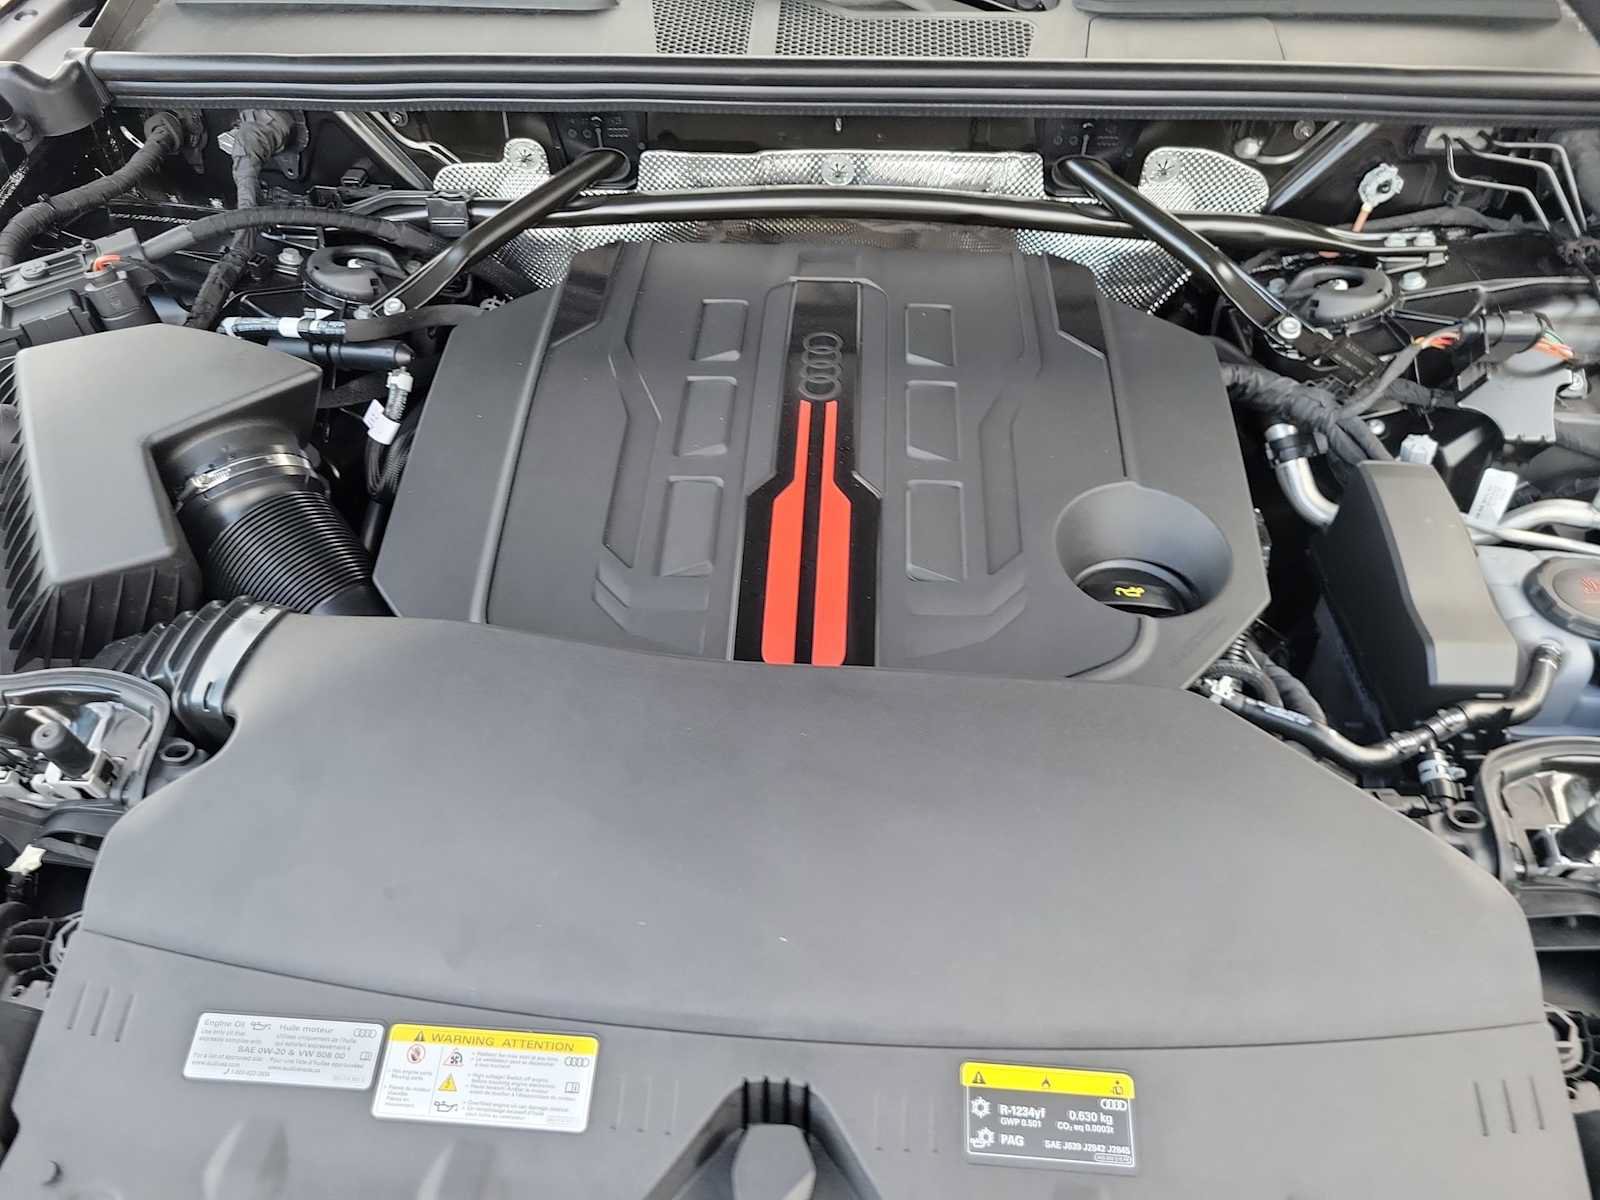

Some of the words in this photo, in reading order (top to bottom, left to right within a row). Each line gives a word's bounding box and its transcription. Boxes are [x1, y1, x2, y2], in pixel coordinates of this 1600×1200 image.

[204, 1019, 233, 1029] Engine
[302, 1025, 334, 1034] moteur
[431, 1032, 494, 1047] WARNING
[502, 1038, 575, 1052] ATTENTION
[237, 1045, 256, 1054] SAE
[257, 1047, 286, 1056] 0W-20
[298, 1049, 314, 1058] VW
[999, 1103, 1046, 1119] R-1234yf
[1068, 1110, 1098, 1123] 0.630
[1100, 1112, 1113, 1125] kg
[1000, 1117, 1020, 1126] GWP
[1000, 1133, 1025, 1147] PAG
[1044, 1140, 1062, 1149] SAE
